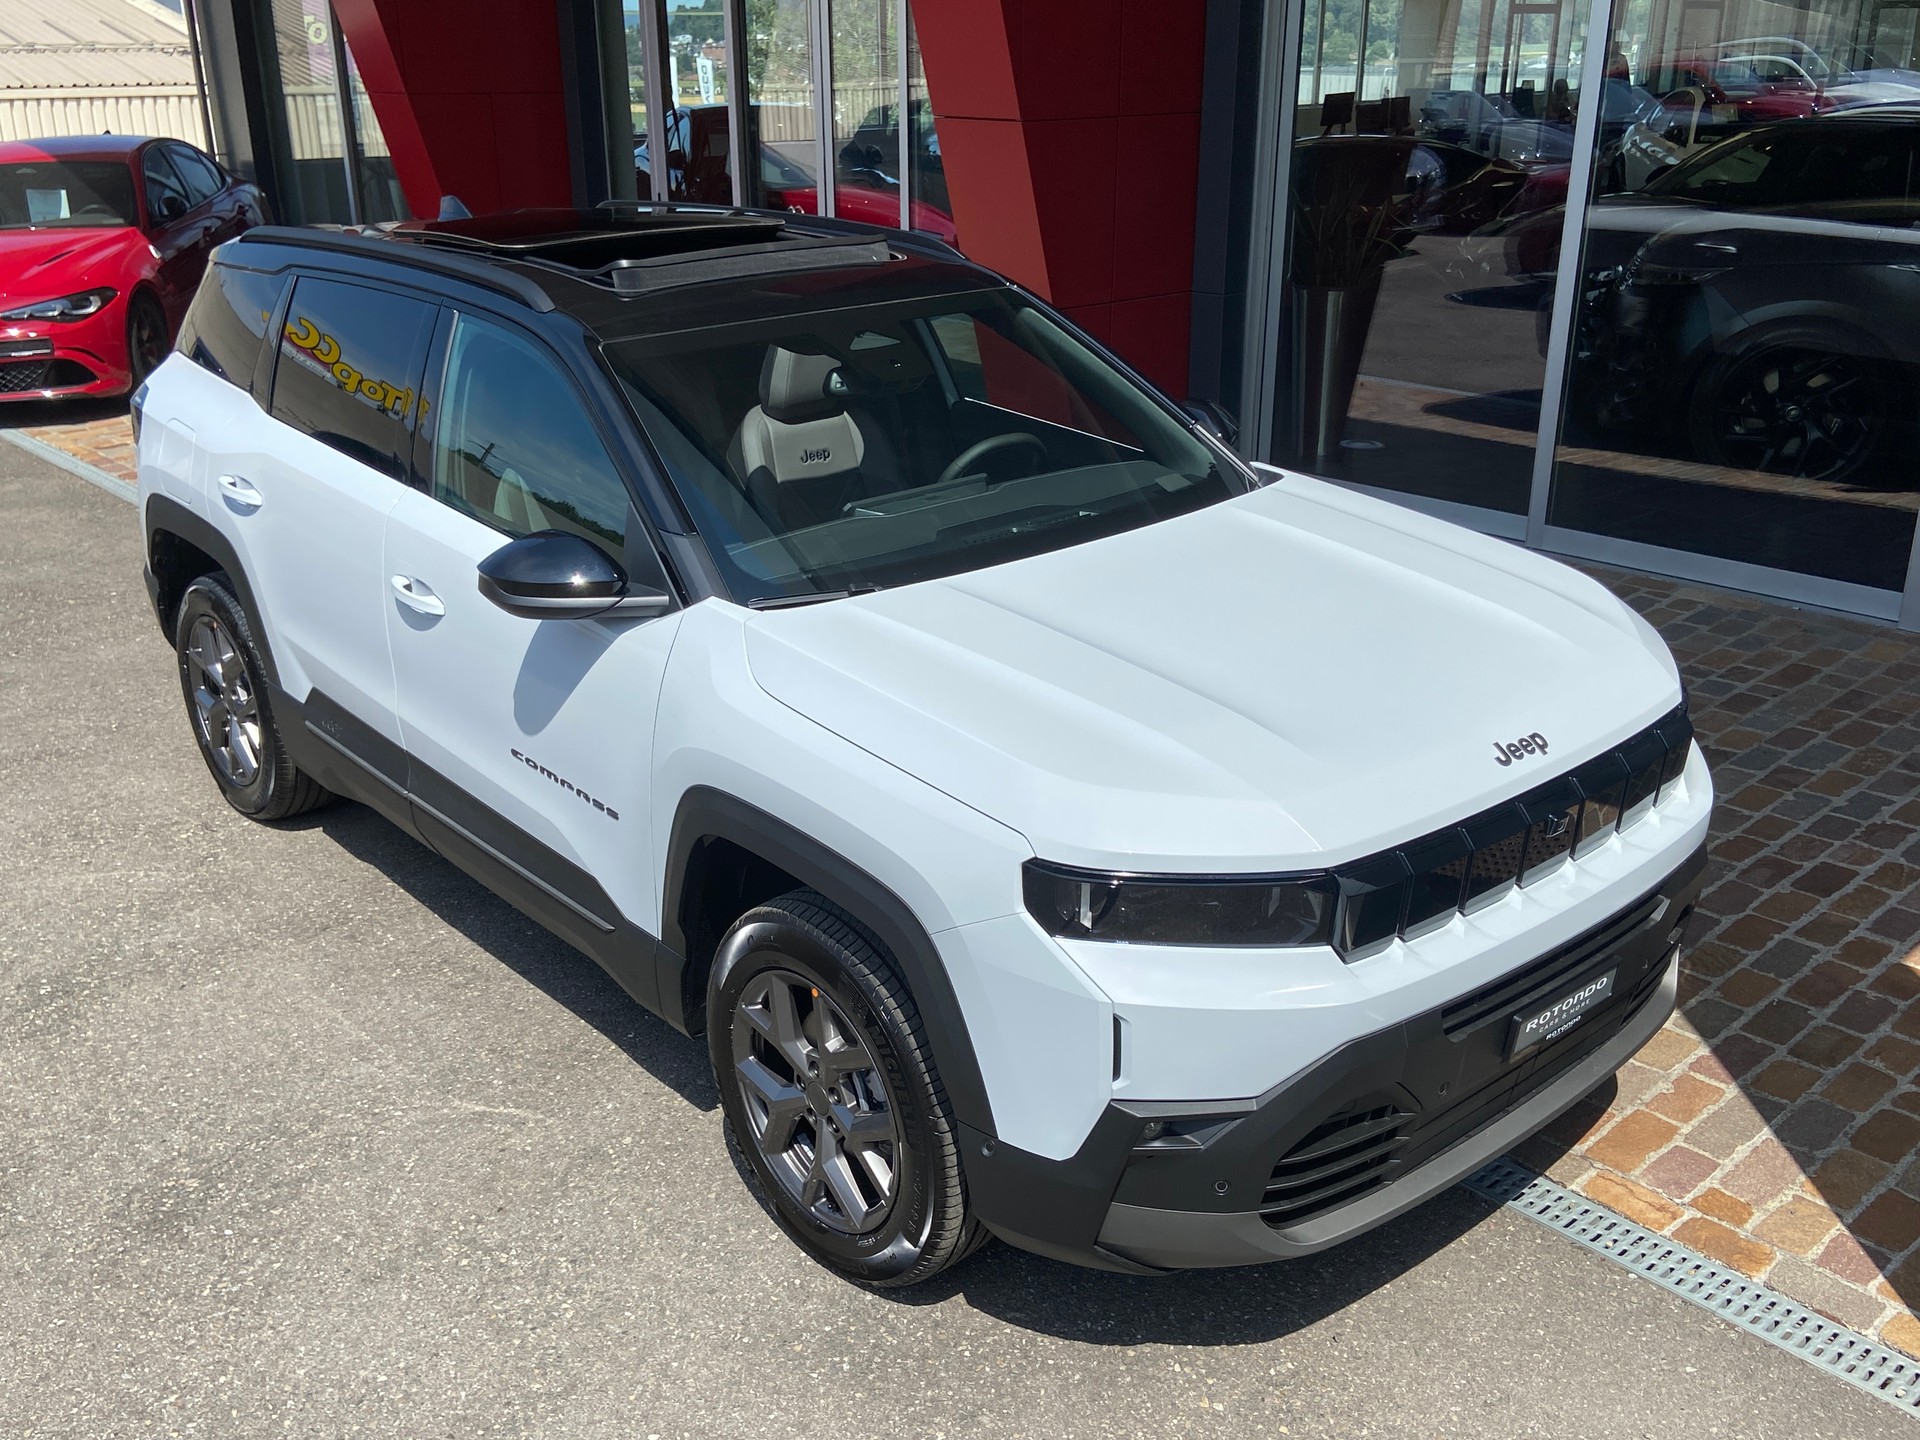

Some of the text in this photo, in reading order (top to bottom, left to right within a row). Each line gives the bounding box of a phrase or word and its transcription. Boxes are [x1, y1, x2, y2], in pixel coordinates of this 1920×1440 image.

[800, 448, 832, 464] Jeep
[1492, 732, 1549, 767] Jeep
[511, 748, 619, 821] COMPASS
[1525, 977, 1608, 1033] ROTONDO
[1539, 1017, 1559, 1033] CARS
[1569, 998, 1591, 1015] MORE
